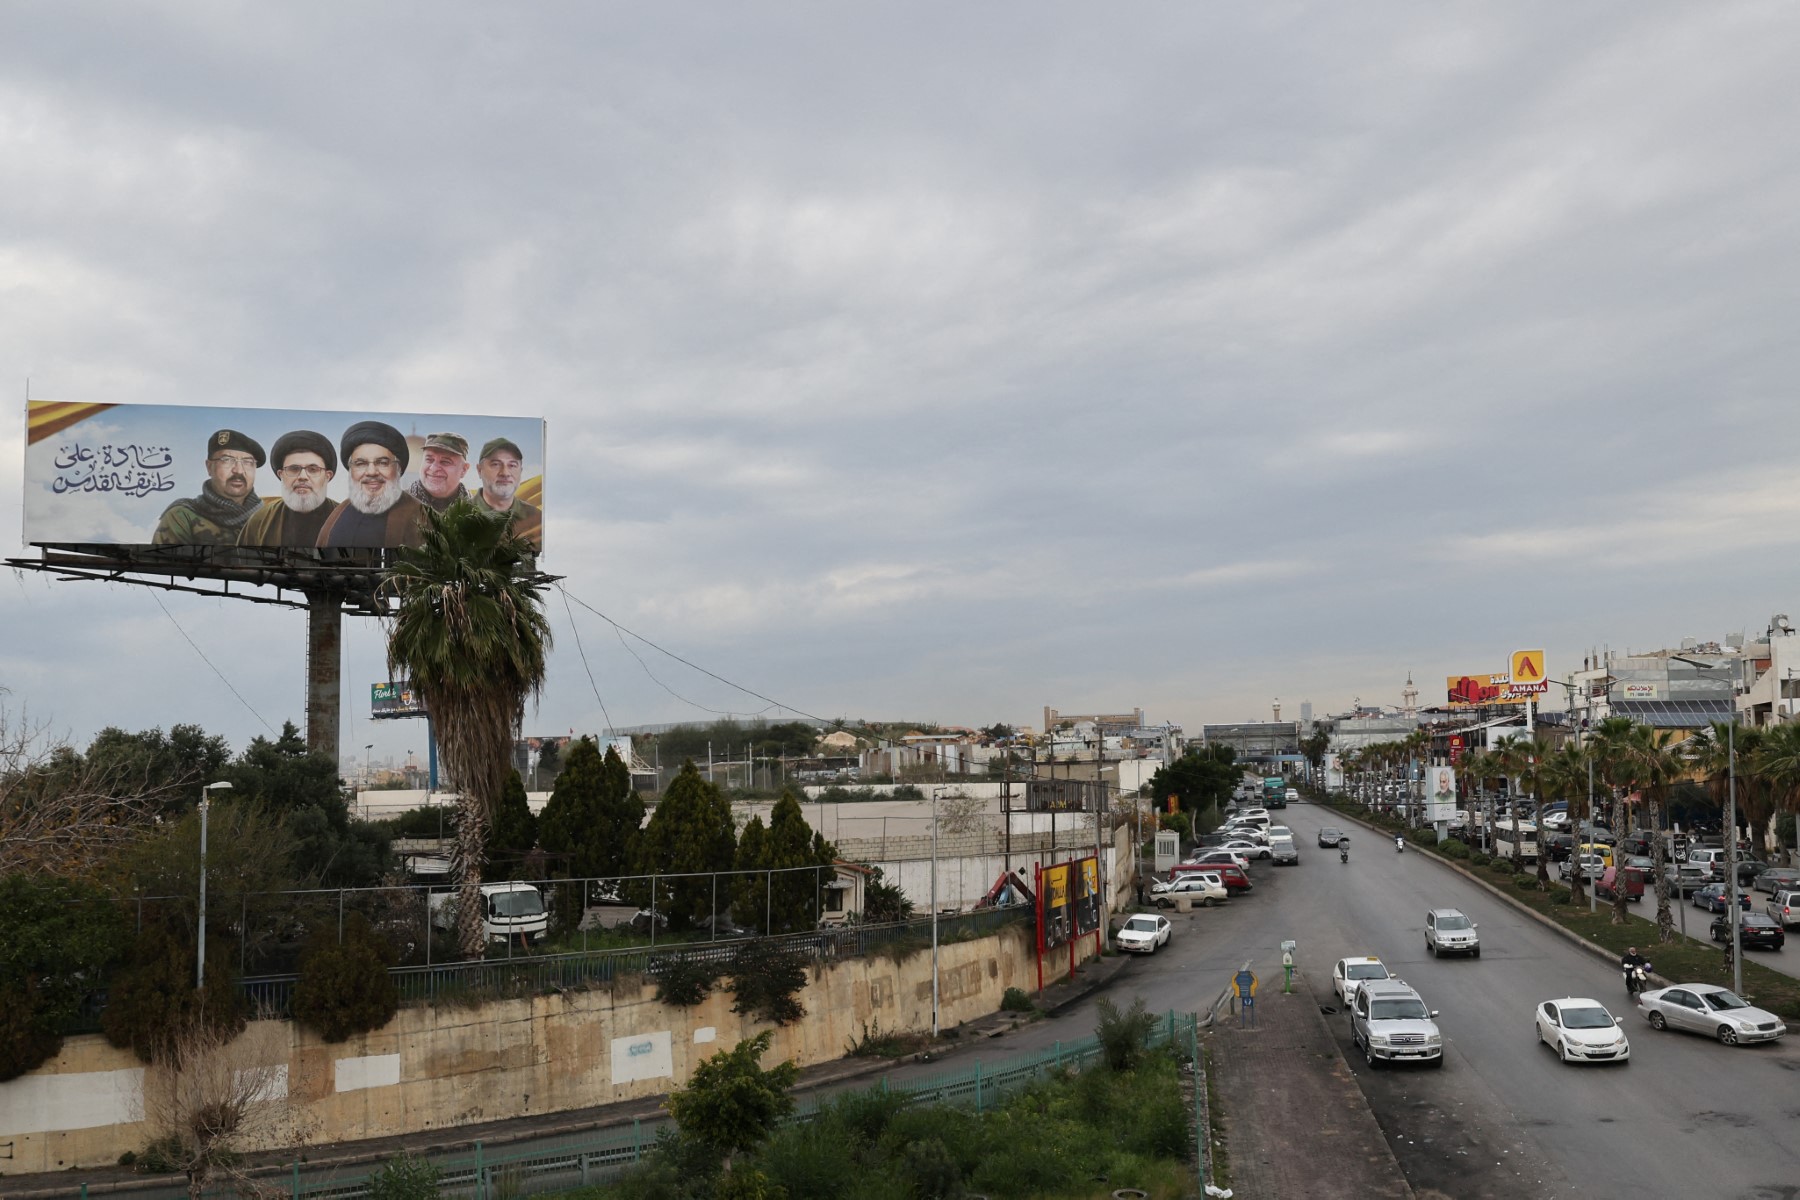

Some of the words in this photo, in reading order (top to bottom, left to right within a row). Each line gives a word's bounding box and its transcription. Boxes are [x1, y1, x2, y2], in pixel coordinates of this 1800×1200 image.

[54, 442, 95, 469] على
[102, 444, 173, 469] قادة
[52, 460, 121, 496] القدس
[116, 463, 176, 498] طريق
[1512, 684, 1547, 692] AMANA
